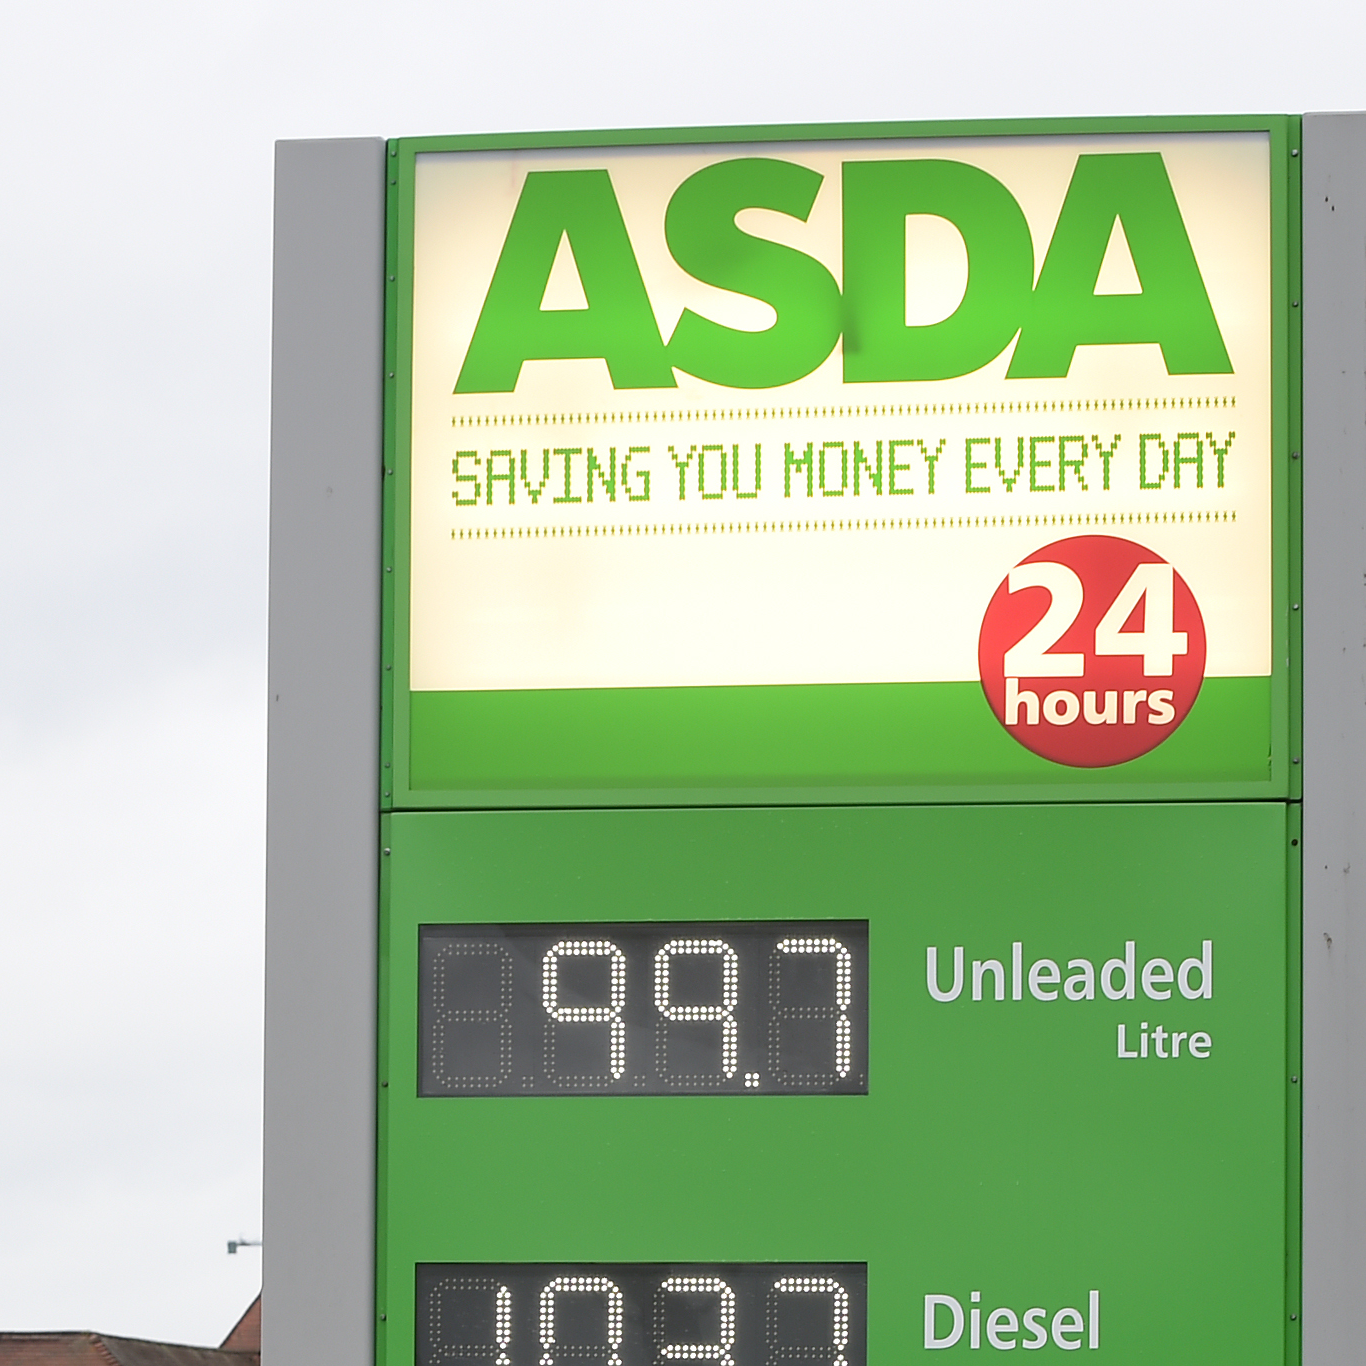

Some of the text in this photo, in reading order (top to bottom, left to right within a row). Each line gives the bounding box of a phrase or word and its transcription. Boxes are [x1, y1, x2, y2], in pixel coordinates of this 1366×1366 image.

[452, 151, 1235, 394] ASDA
[451, 430, 1236, 506] SAVING YOU MONEY EVERY DAY
[1002, 561, 1189, 678] 24
[1004, 677, 1176, 726] hours
[925, 939, 1213, 1003] Unleaded
[540, 937, 853, 1089] 99.7
[1117, 1023, 1212, 1060] Litre
[923, 1290, 1101, 1350] Diesel
